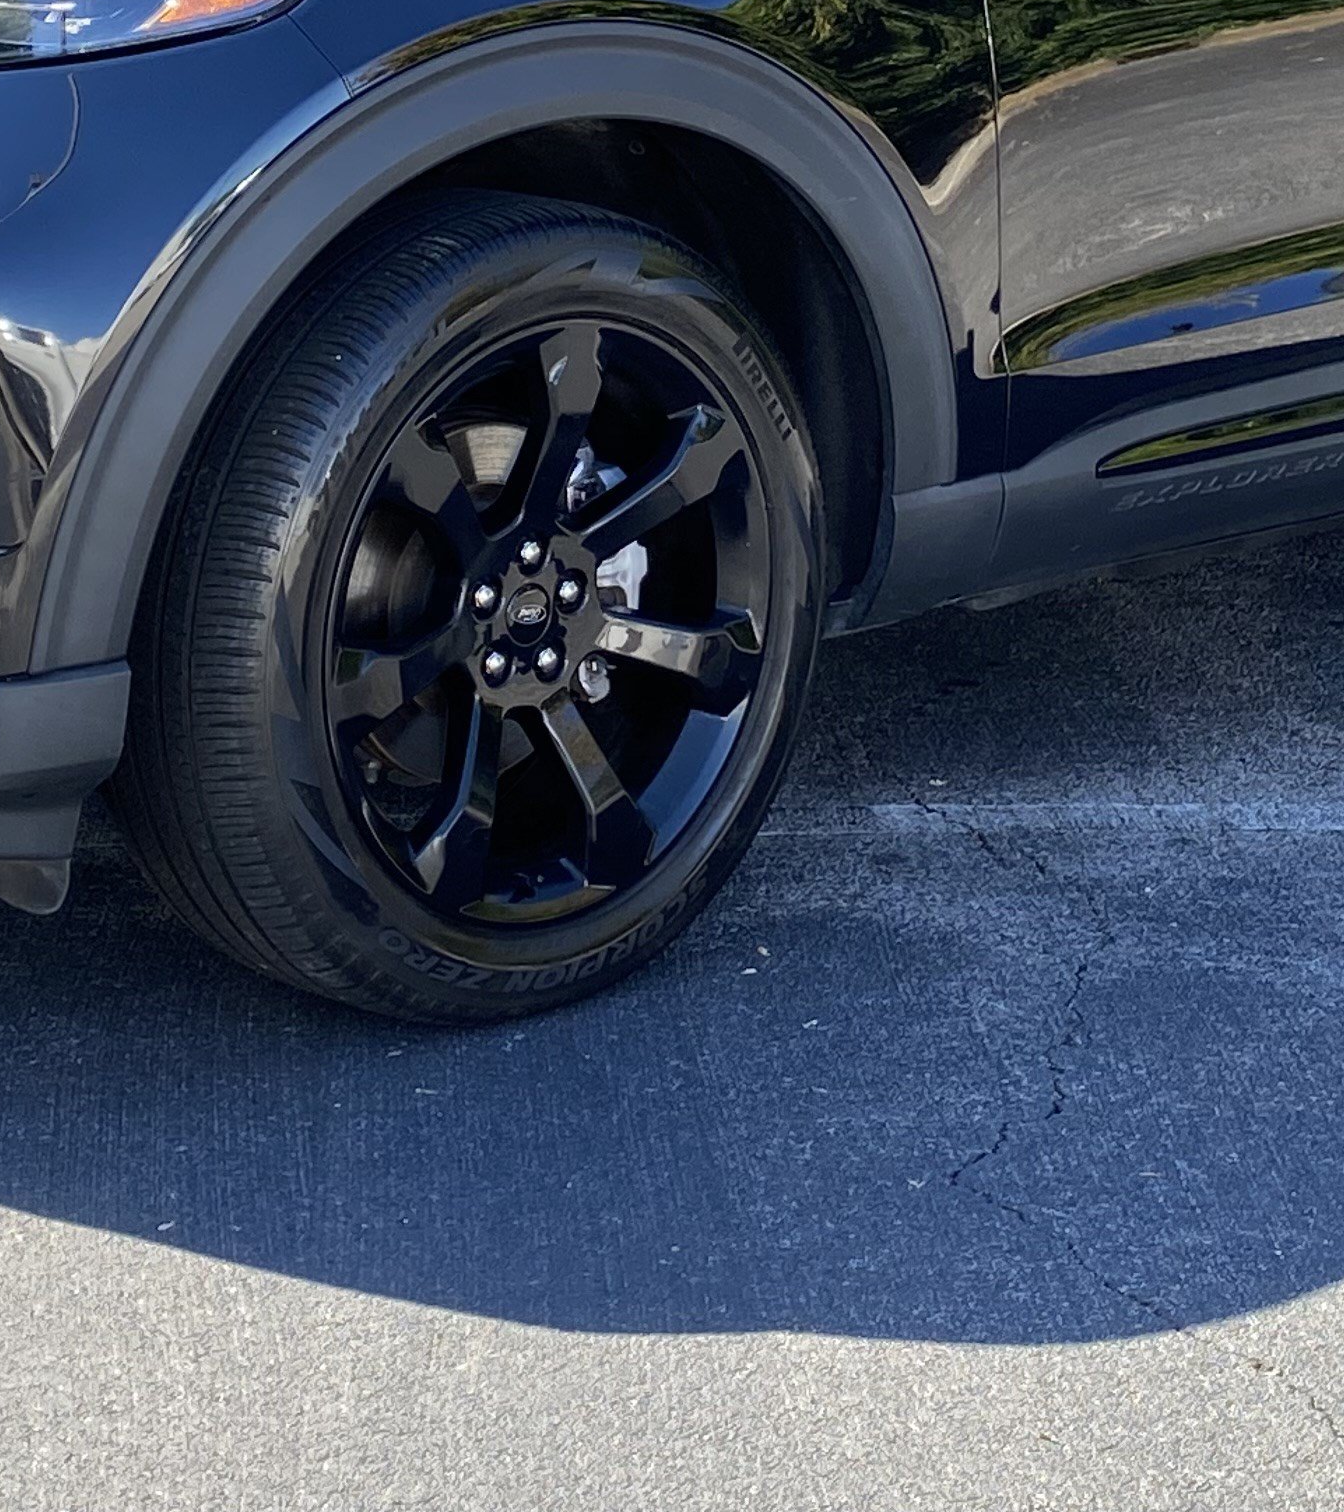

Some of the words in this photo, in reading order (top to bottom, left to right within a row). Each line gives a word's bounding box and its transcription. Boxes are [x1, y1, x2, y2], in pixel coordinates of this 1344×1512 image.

[731, 330, 797, 443] PIRELLI
[377, 928, 494, 991] ZERO
[502, 861, 711, 994] SCORPION
